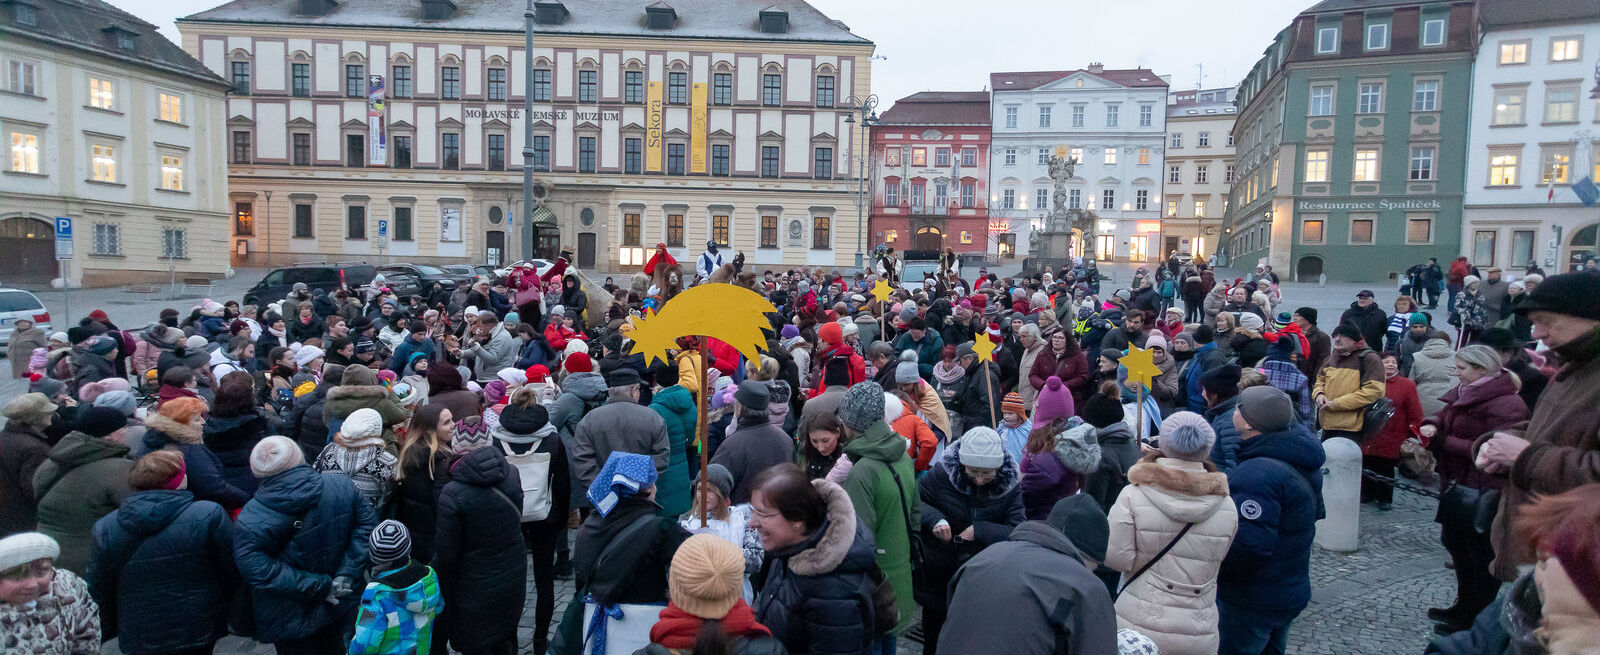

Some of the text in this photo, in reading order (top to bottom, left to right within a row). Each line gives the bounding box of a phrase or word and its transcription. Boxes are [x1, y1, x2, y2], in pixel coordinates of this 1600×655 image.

[465, 109, 620, 121] MORAVSKÉ EMSKÉ MUZEUM
[648, 100, 660, 148] Sekora
[1300, 201, 1375, 210] Restaurace
[59, 219, 69, 232] P
[380, 221, 385, 231] P
